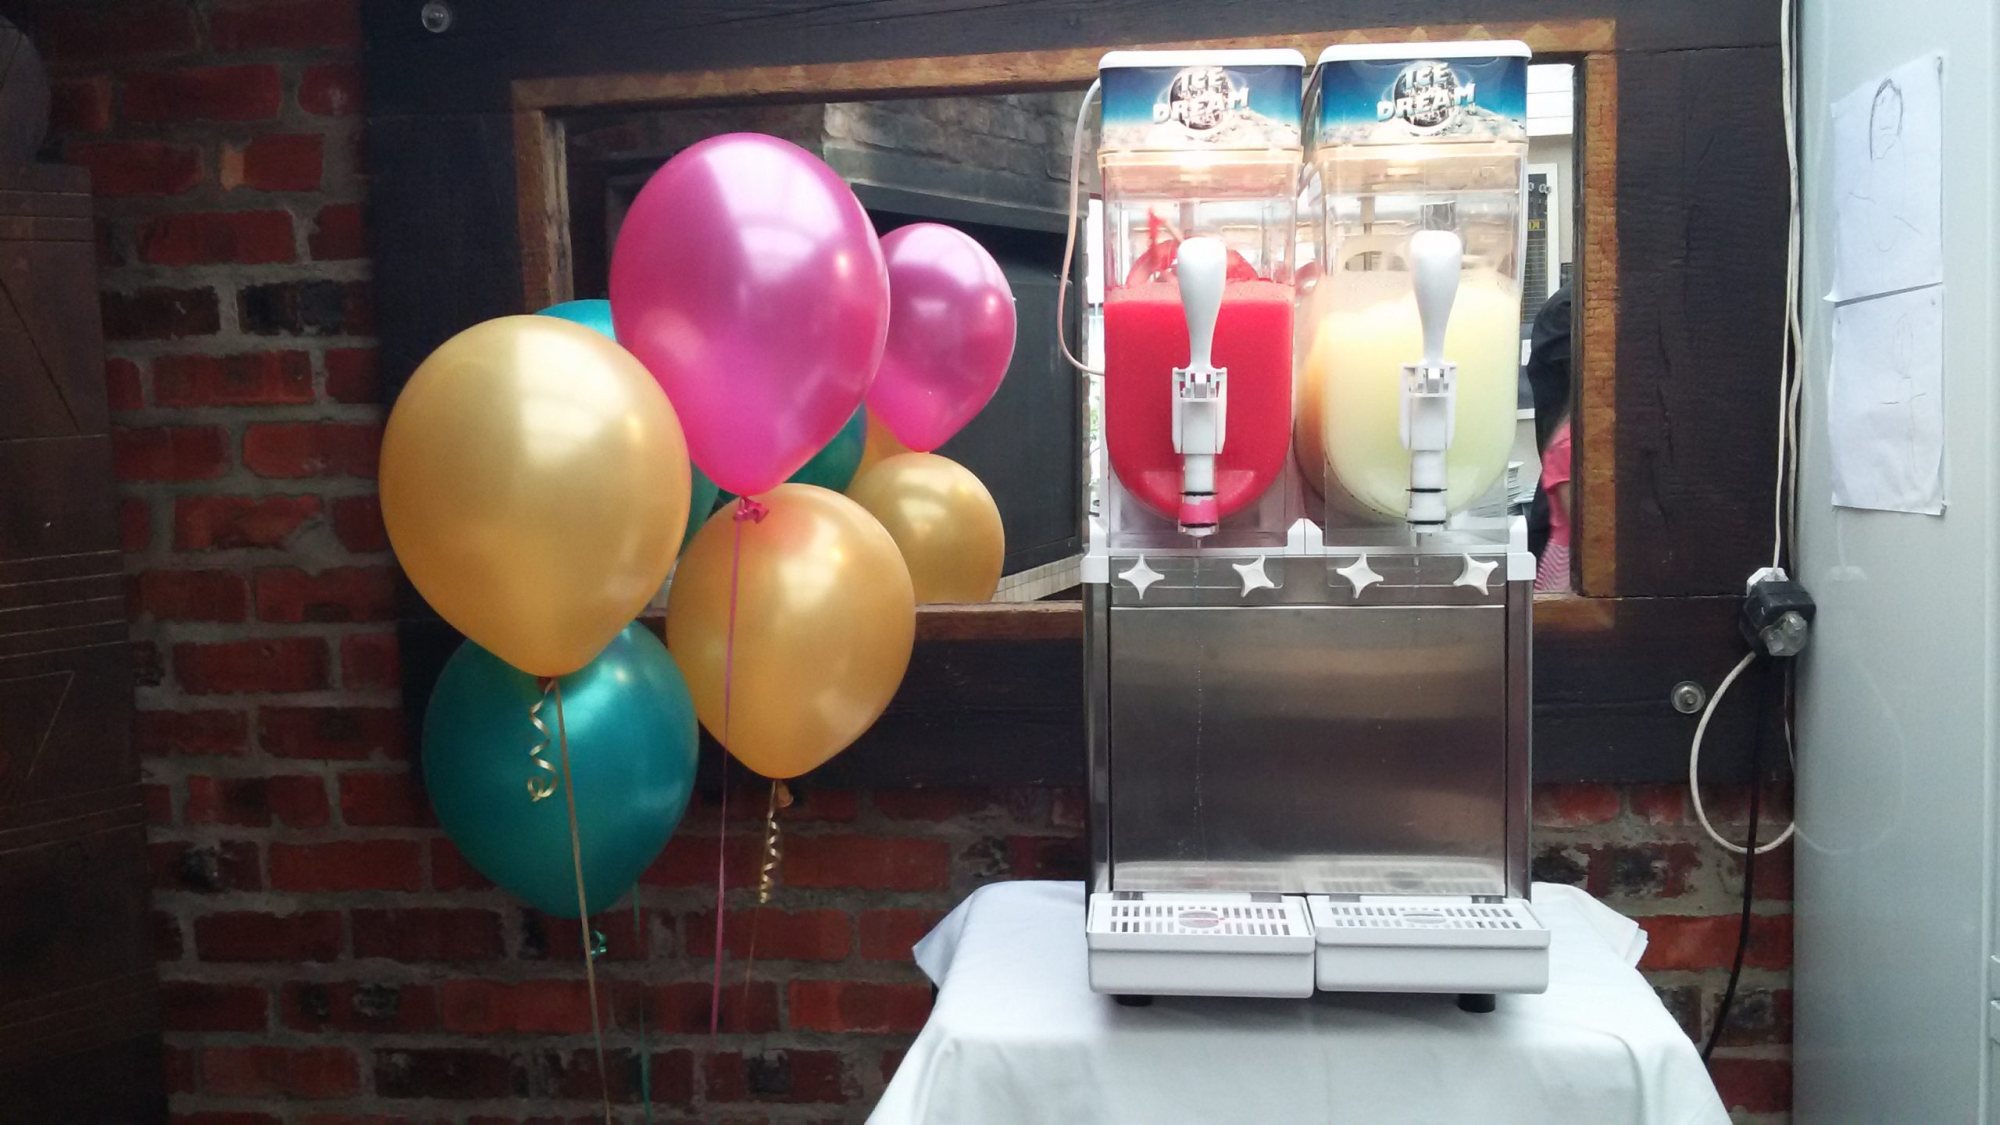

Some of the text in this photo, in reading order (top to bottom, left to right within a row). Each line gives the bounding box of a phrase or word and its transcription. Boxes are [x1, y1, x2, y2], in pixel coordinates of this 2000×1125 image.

[1179, 67, 1226, 92] ICE
[1403, 62, 1450, 89] ICE
[1152, 87, 1250, 124] DREAM
[1376, 82, 1476, 122] DREAM
